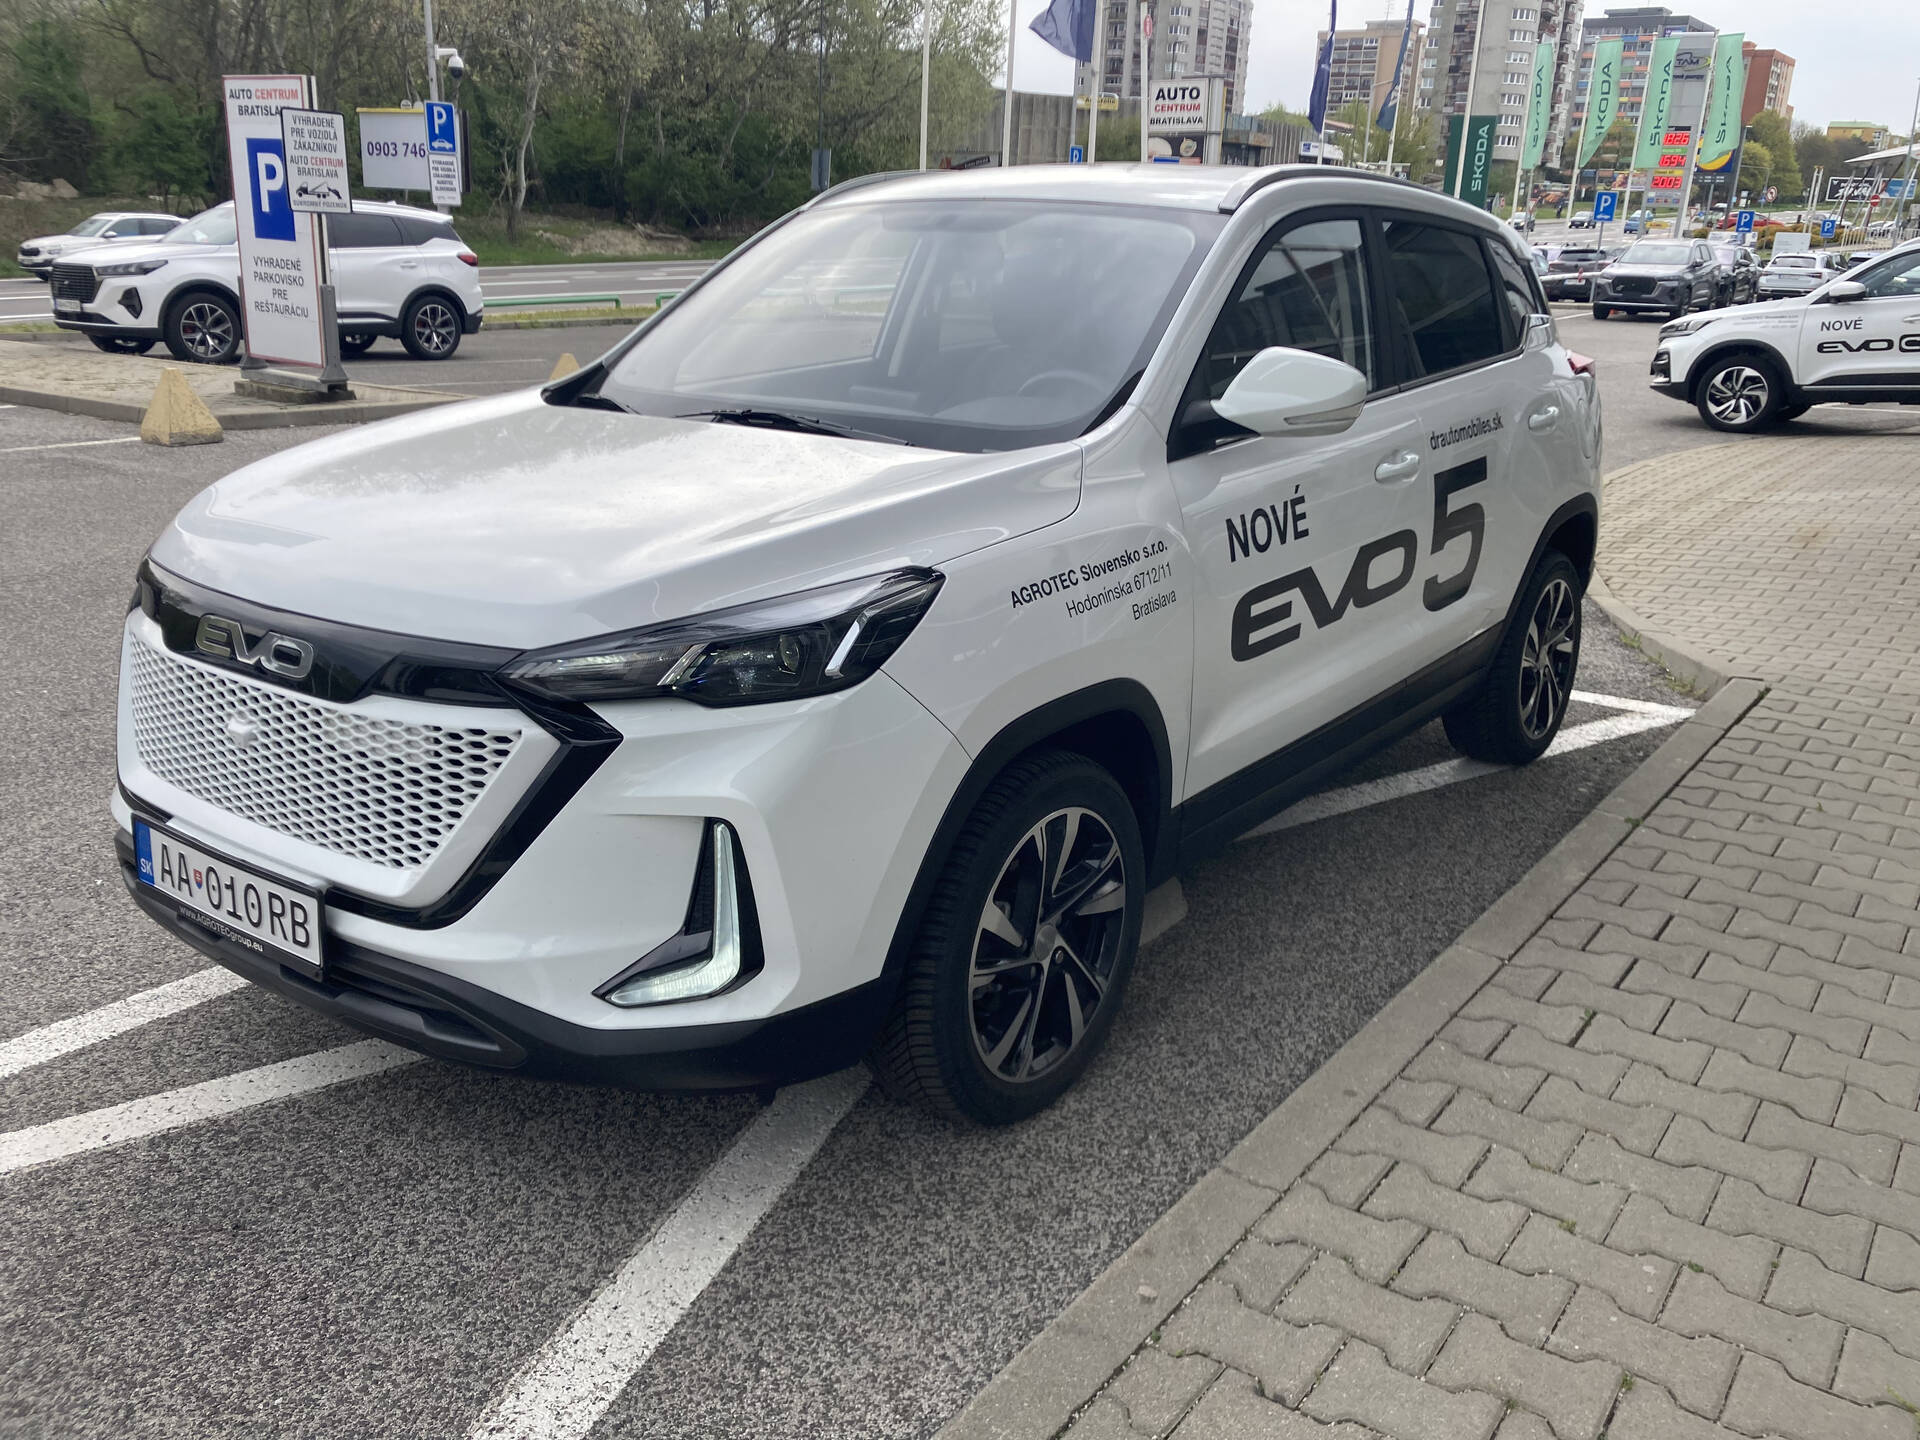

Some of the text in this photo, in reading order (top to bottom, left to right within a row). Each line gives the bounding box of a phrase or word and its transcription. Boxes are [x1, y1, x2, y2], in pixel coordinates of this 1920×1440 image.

[229, 88, 298, 100] AUTO CENTRUM
[1155, 87, 1200, 100] AUTO
[238, 105, 285, 116] BRATISLA
[1154, 103, 1201, 113] CENTRUM
[292, 115, 335, 128] VYHRADENÉ
[433, 105, 447, 135] P
[1150, 116, 1203, 125] BRATISLAVA
[291, 127, 338, 141] PRE VOZIDLÁ
[293, 140, 337, 153] ZÁKAZNÍKOV
[367, 141, 426, 158] 0903 746
[290, 155, 344, 168] AUTO CENTRUM
[297, 167, 338, 178] BRATISLAVA
[256, 152, 284, 213] P
[1600, 195, 1612, 212] P
[1742, 213, 1750, 223] P
[1825, 222, 1832, 231] P
[253, 256, 301, 271] VYHRADENÉ
[254, 272, 305, 287] PARKOVISKO
[272, 288, 288, 300] PRE
[254, 300, 309, 318] REŠTAURÁCIU
[1820, 317, 1863, 331] NOVÉ
[1430, 412, 1504, 450] drautomobiles.sk
[1225, 484, 1309, 563] NOVÉ
[1011, 540, 1168, 609] AGROTEC Slovensko s.r.o.
[1134, 562, 1172, 591] 6712/11
[1132, 590, 1177, 621] Bratislava
[195, 614, 314, 679] EVO
[140, 857, 153, 876] SK
[179, 906, 264, 952] www.AGROTECgroup.eu
